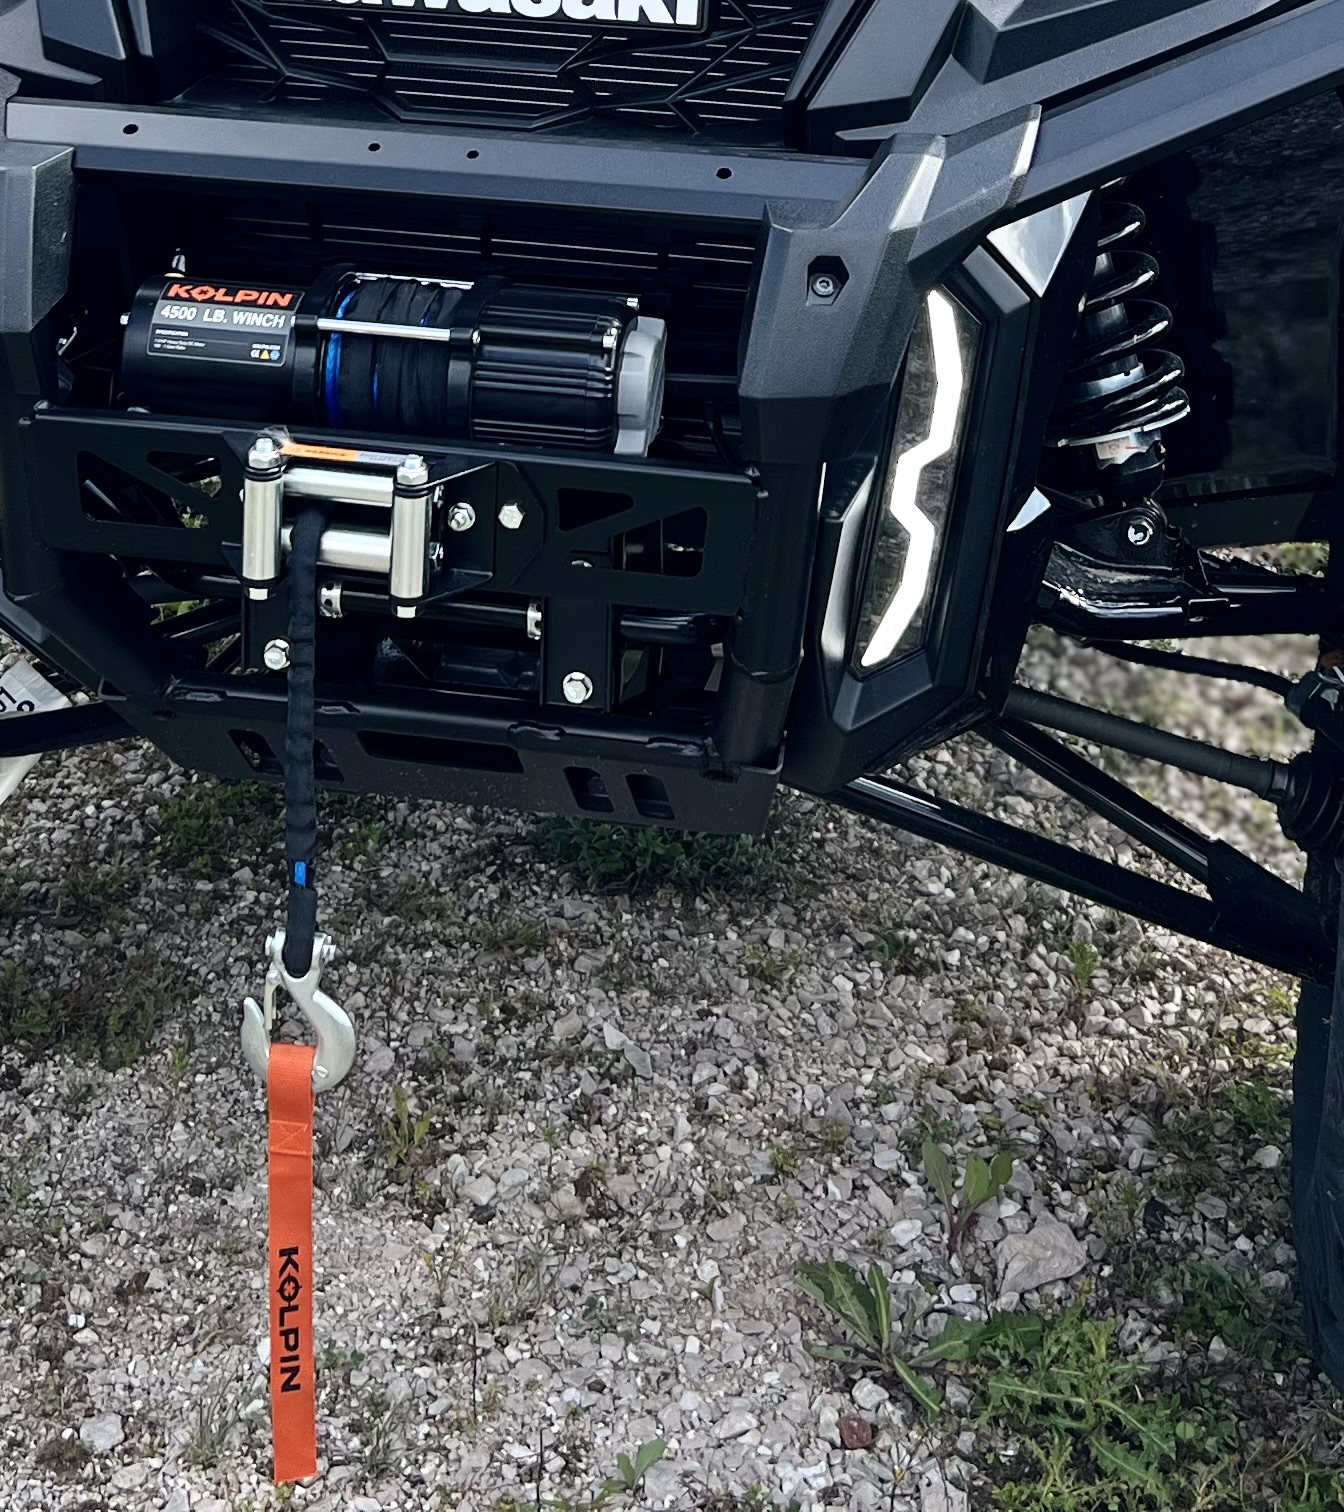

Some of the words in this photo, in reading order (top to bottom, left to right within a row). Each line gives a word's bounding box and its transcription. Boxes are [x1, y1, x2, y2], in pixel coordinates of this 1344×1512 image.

[167, 283, 293, 307] KOLPIN
[160, 304, 197, 321] 4500
[202, 307, 228, 324] LB.
[232, 310, 286, 329] WINCH
[277, 1245, 301, 1394] KOLPIN
